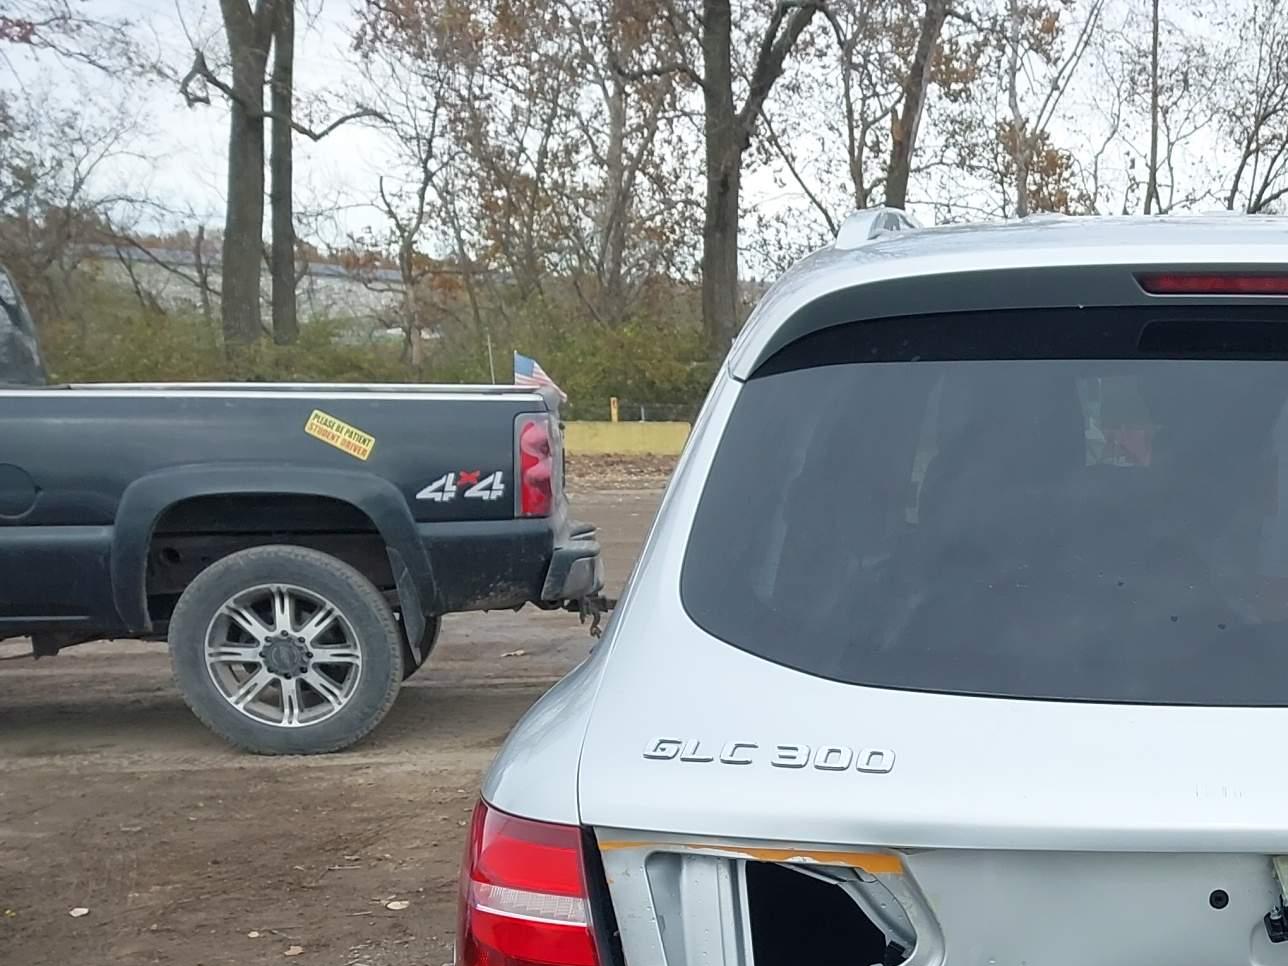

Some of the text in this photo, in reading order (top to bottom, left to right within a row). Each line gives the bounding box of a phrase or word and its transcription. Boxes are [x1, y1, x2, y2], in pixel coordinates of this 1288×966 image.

[308, 422, 368, 458] STUDENT DRIVER
[313, 413, 372, 447] PLEASE BE PATIENT
[643, 738, 897, 774] GLC 300
